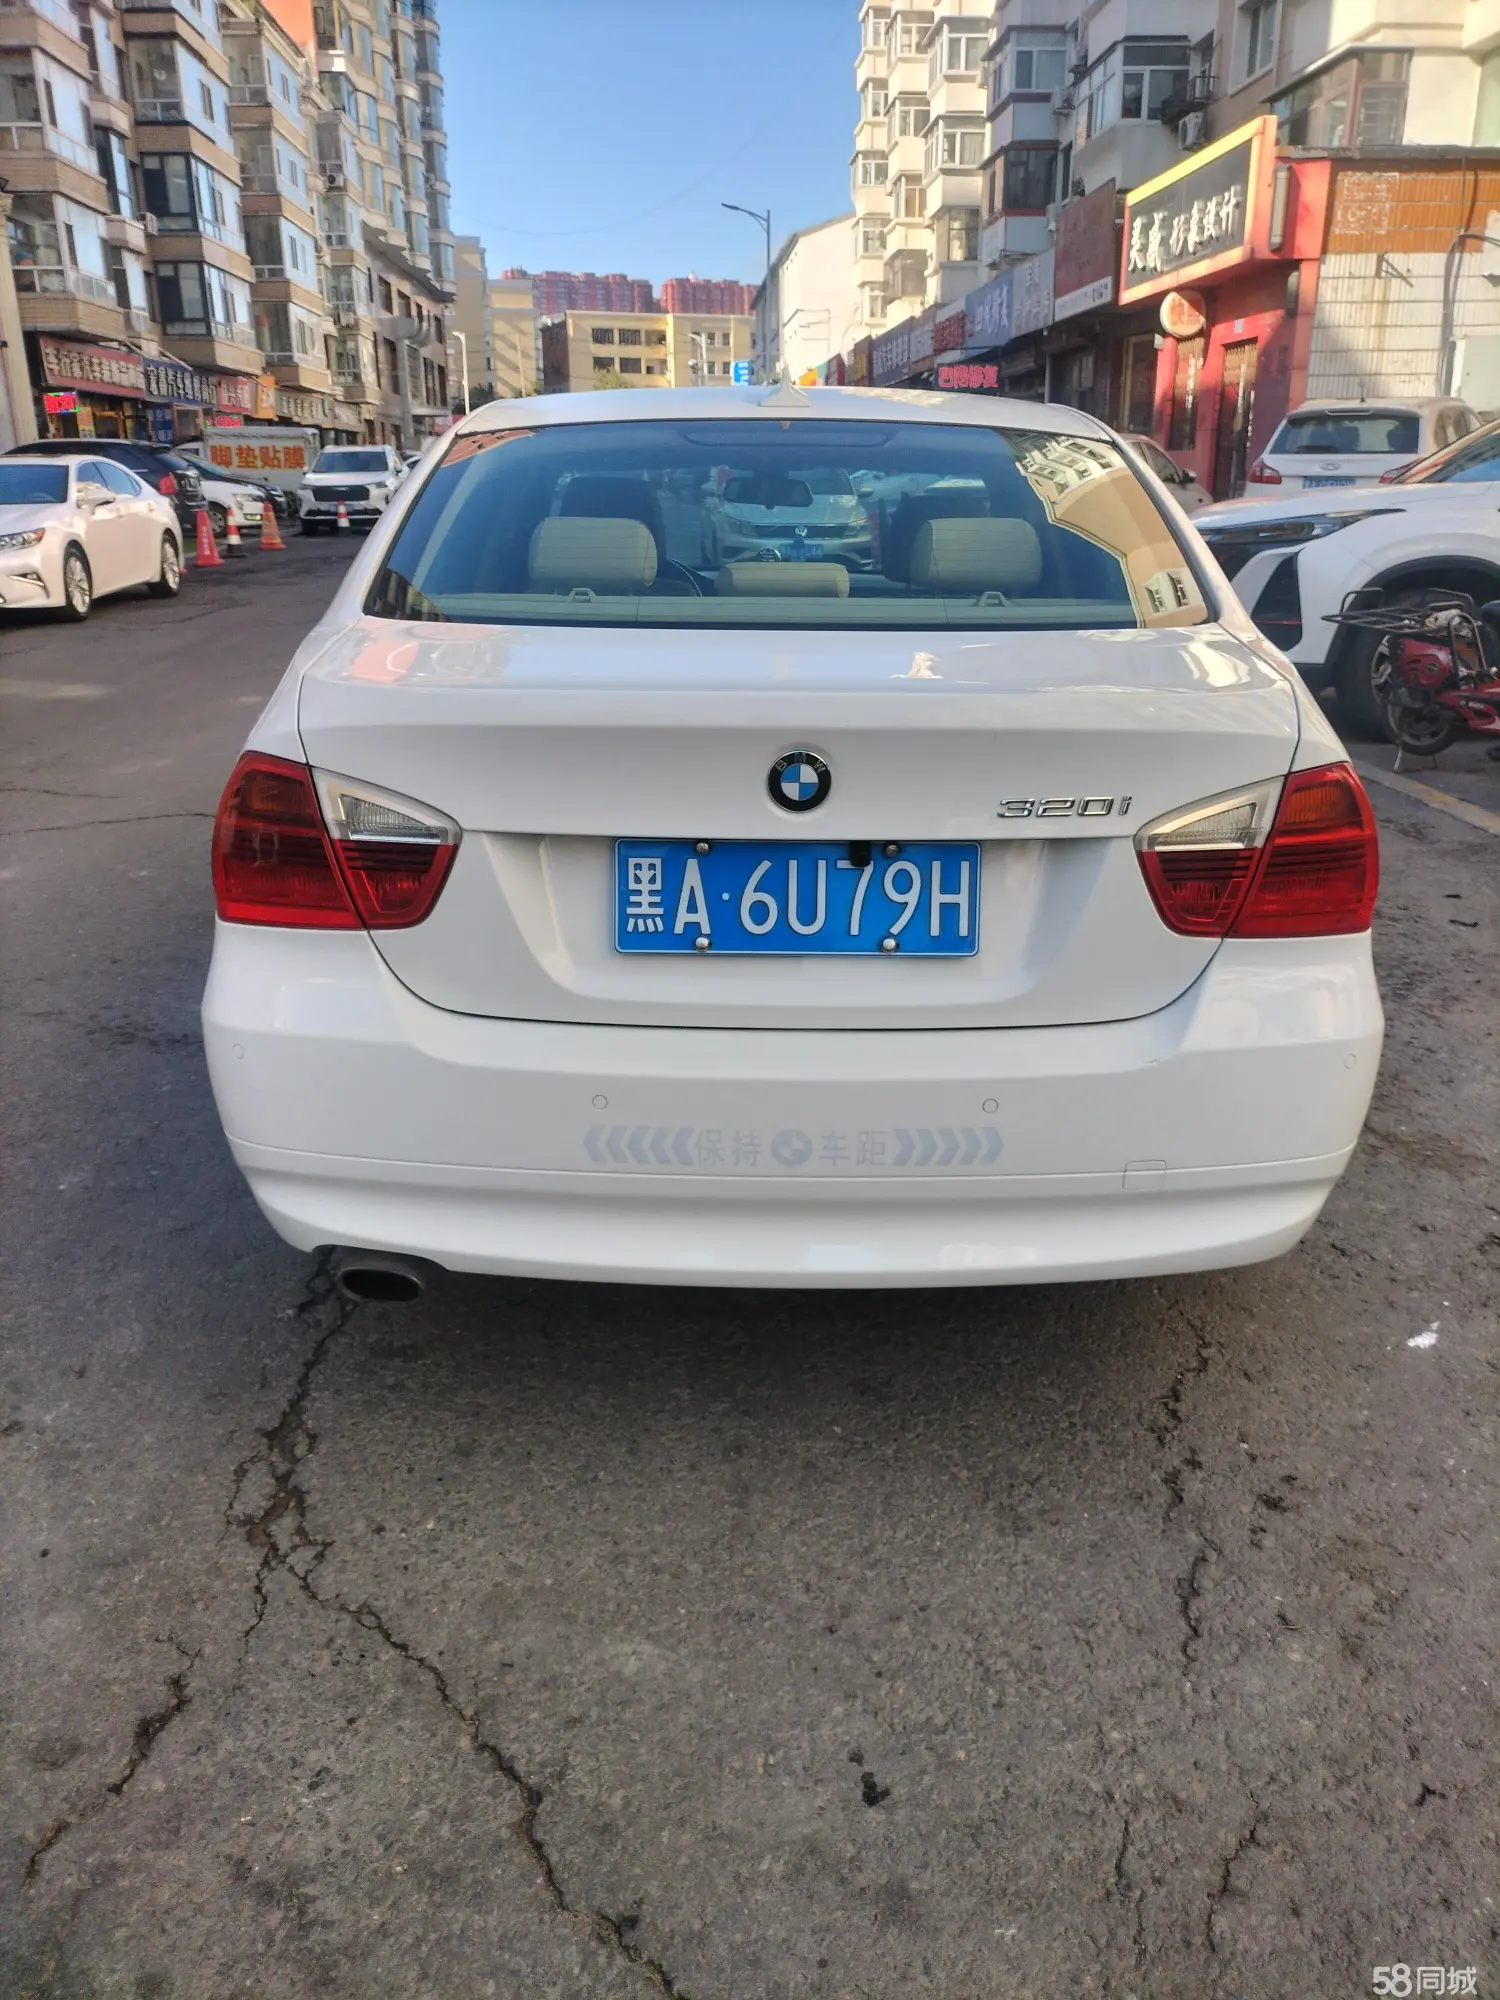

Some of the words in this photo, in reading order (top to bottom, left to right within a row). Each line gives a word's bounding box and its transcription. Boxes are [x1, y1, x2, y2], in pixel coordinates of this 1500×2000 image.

[210, 444, 305, 469] 脚垫贴膜
[775, 752, 827, 774] BMW
[997, 796, 1132, 818] 320i
[626, 858, 970, 937] 黑A·6U79H
[693, 1129, 764, 1168] 保持
[818, 1128, 890, 1168] 车距
